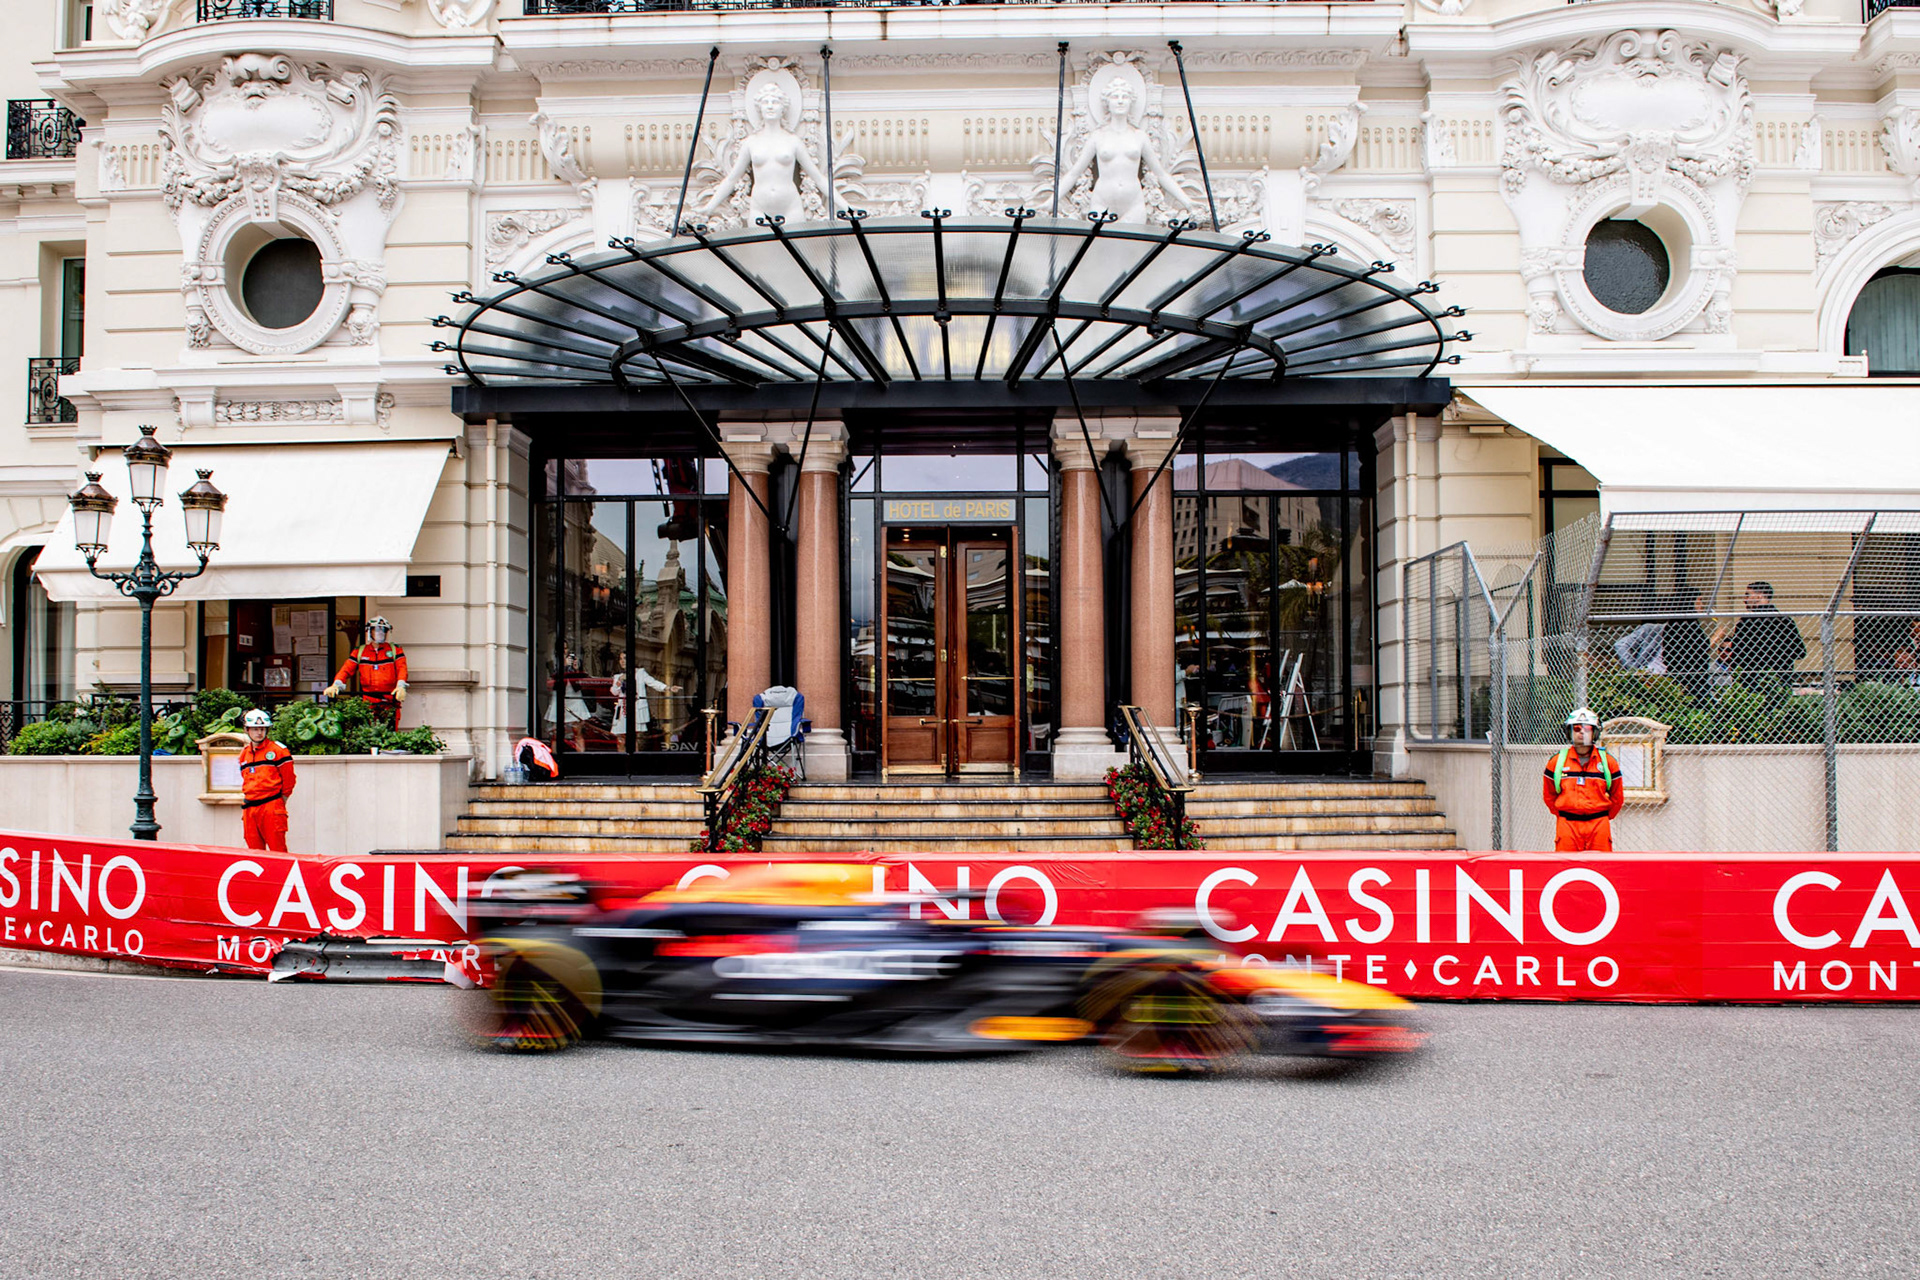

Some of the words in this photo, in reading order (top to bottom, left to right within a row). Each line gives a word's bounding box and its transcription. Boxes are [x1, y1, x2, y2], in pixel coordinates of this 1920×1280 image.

[888, 502, 940, 519] HOTEL
[943, 502, 961, 519] de
[965, 501, 1010, 518] PARIS
[1195, 864, 1620, 945] CASINO
[1773, 867, 1920, 950] CA
[39, 920, 144, 956] CARLO
[1433, 955, 1620, 987] CARLO
